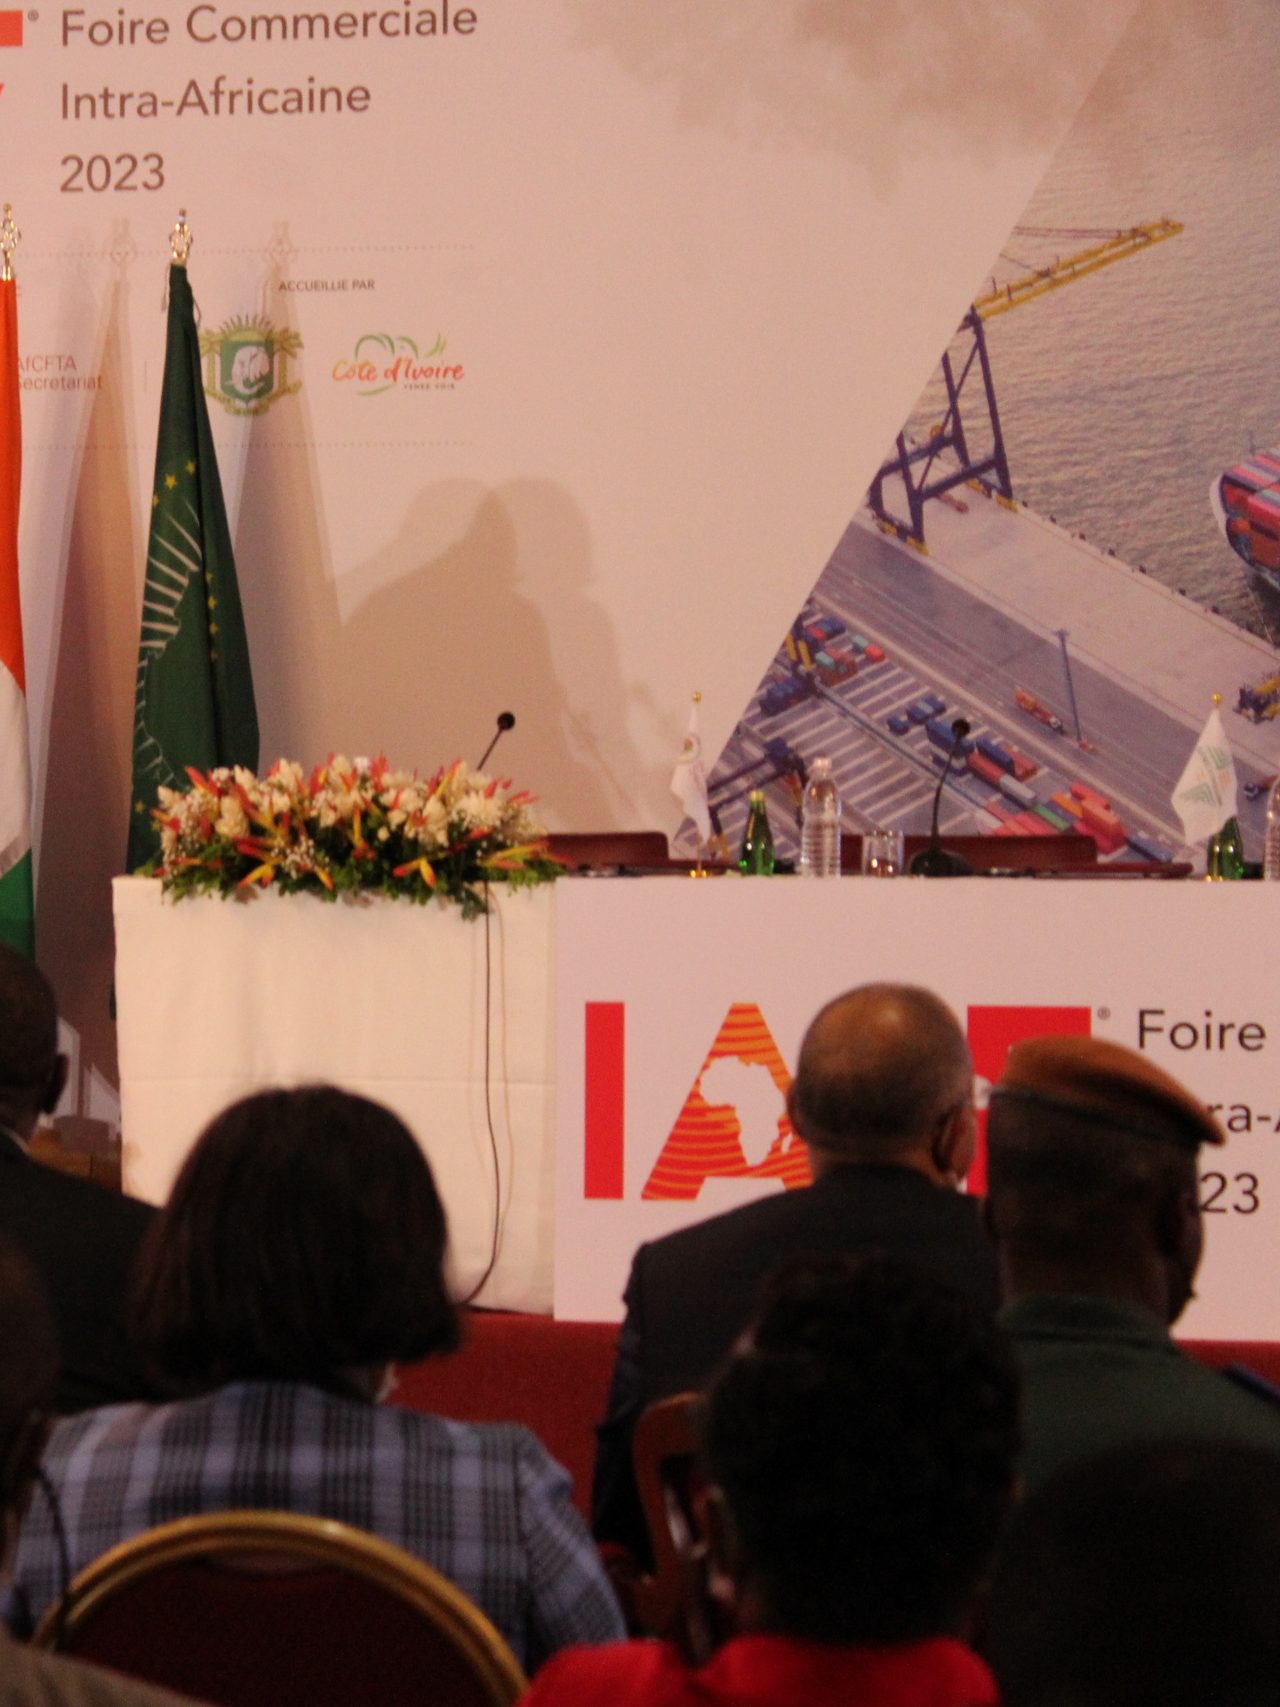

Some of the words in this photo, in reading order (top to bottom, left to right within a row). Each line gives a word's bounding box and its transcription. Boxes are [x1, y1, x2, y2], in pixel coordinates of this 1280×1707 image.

[62, 9, 169, 46] Foire
[186, 0, 478, 43] Commerciale
[62, 76, 371, 119] Intra-Africaine
[60, 153, 165, 192] 2023
[278, 280, 349, 292] ACCUEILLIE
[352, 279, 375, 290] PAR
[1139, 1009, 1266, 1051] Foire
